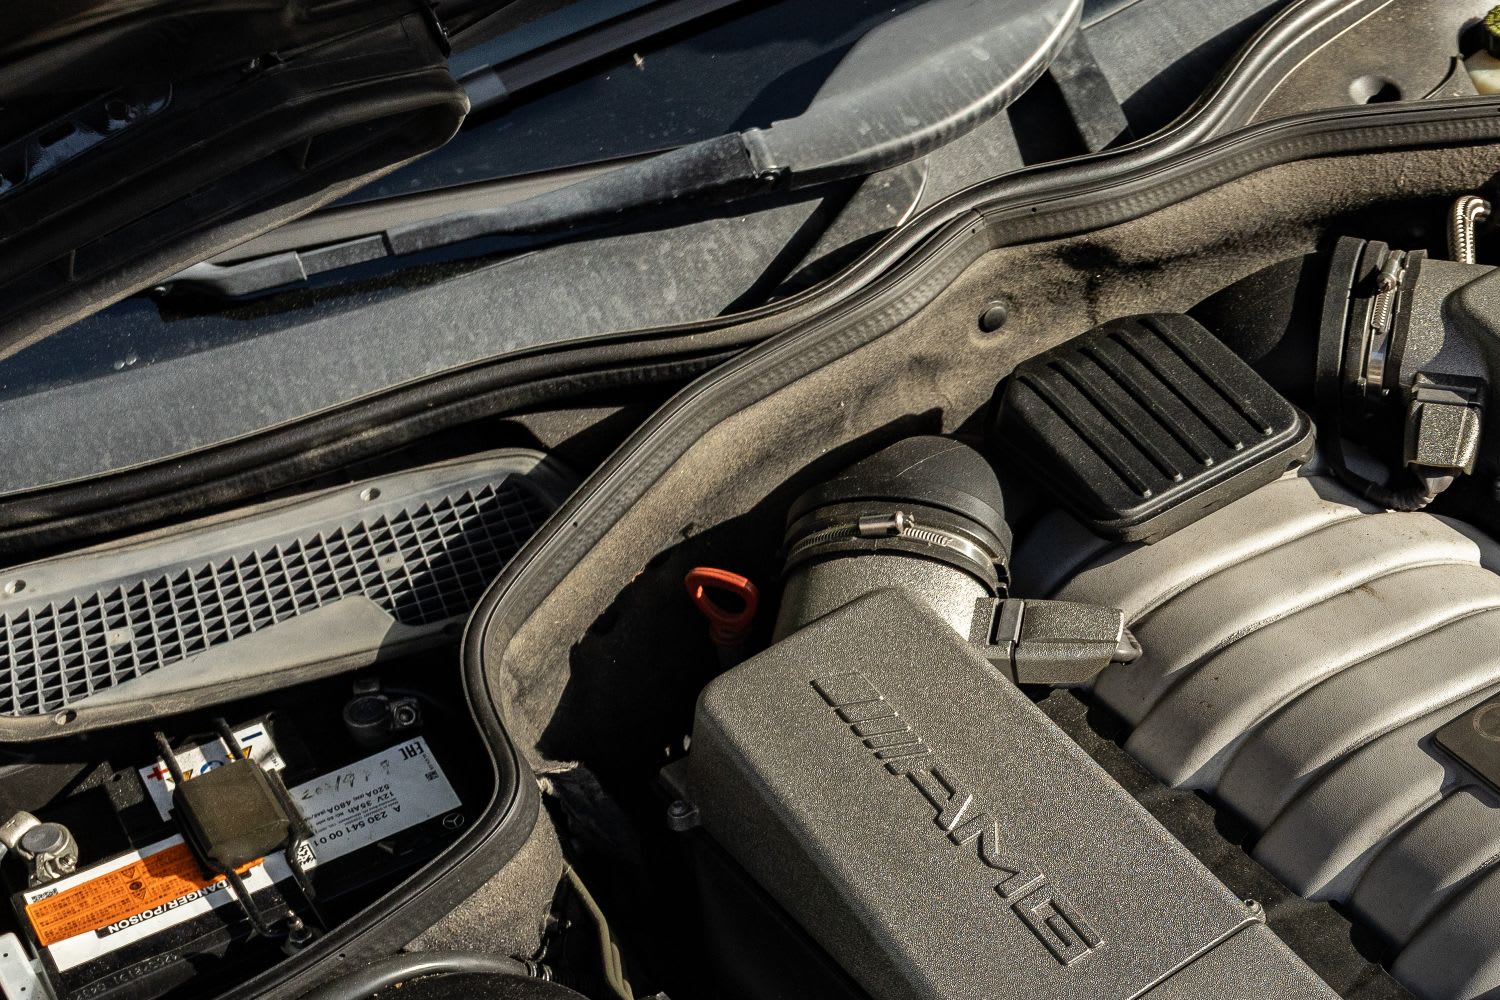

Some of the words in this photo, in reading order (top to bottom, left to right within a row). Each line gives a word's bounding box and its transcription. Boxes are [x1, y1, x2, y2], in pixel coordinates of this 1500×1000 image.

[366, 784, 390, 798] 520A
[377, 791, 394, 803] 12V
[326, 800, 351, 814] 480A
[347, 800, 373, 814] 35Ah
[367, 811, 388, 825] 230
[346, 821, 367, 834] 541
[328, 830, 343, 841] 00
[108, 879, 229, 935] DANGER/POISON
